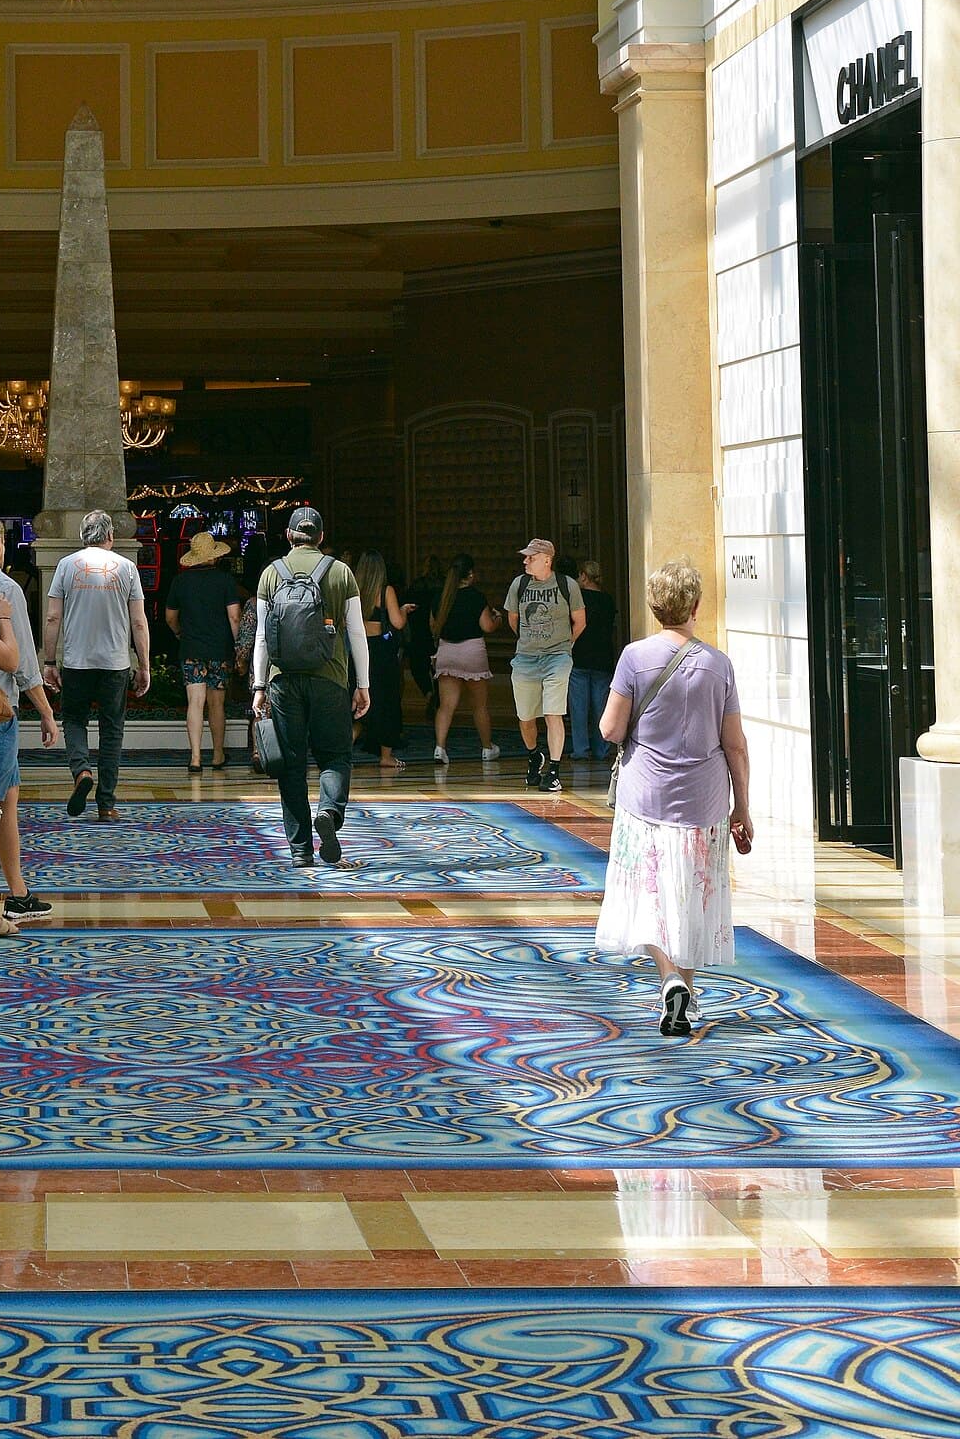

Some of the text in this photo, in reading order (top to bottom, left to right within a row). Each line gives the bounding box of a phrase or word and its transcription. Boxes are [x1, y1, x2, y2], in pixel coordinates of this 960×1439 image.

[837, 30, 919, 125] CHANEL
[731, 554, 758, 580] CHANEL
[520, 586, 559, 605] RUMPY
